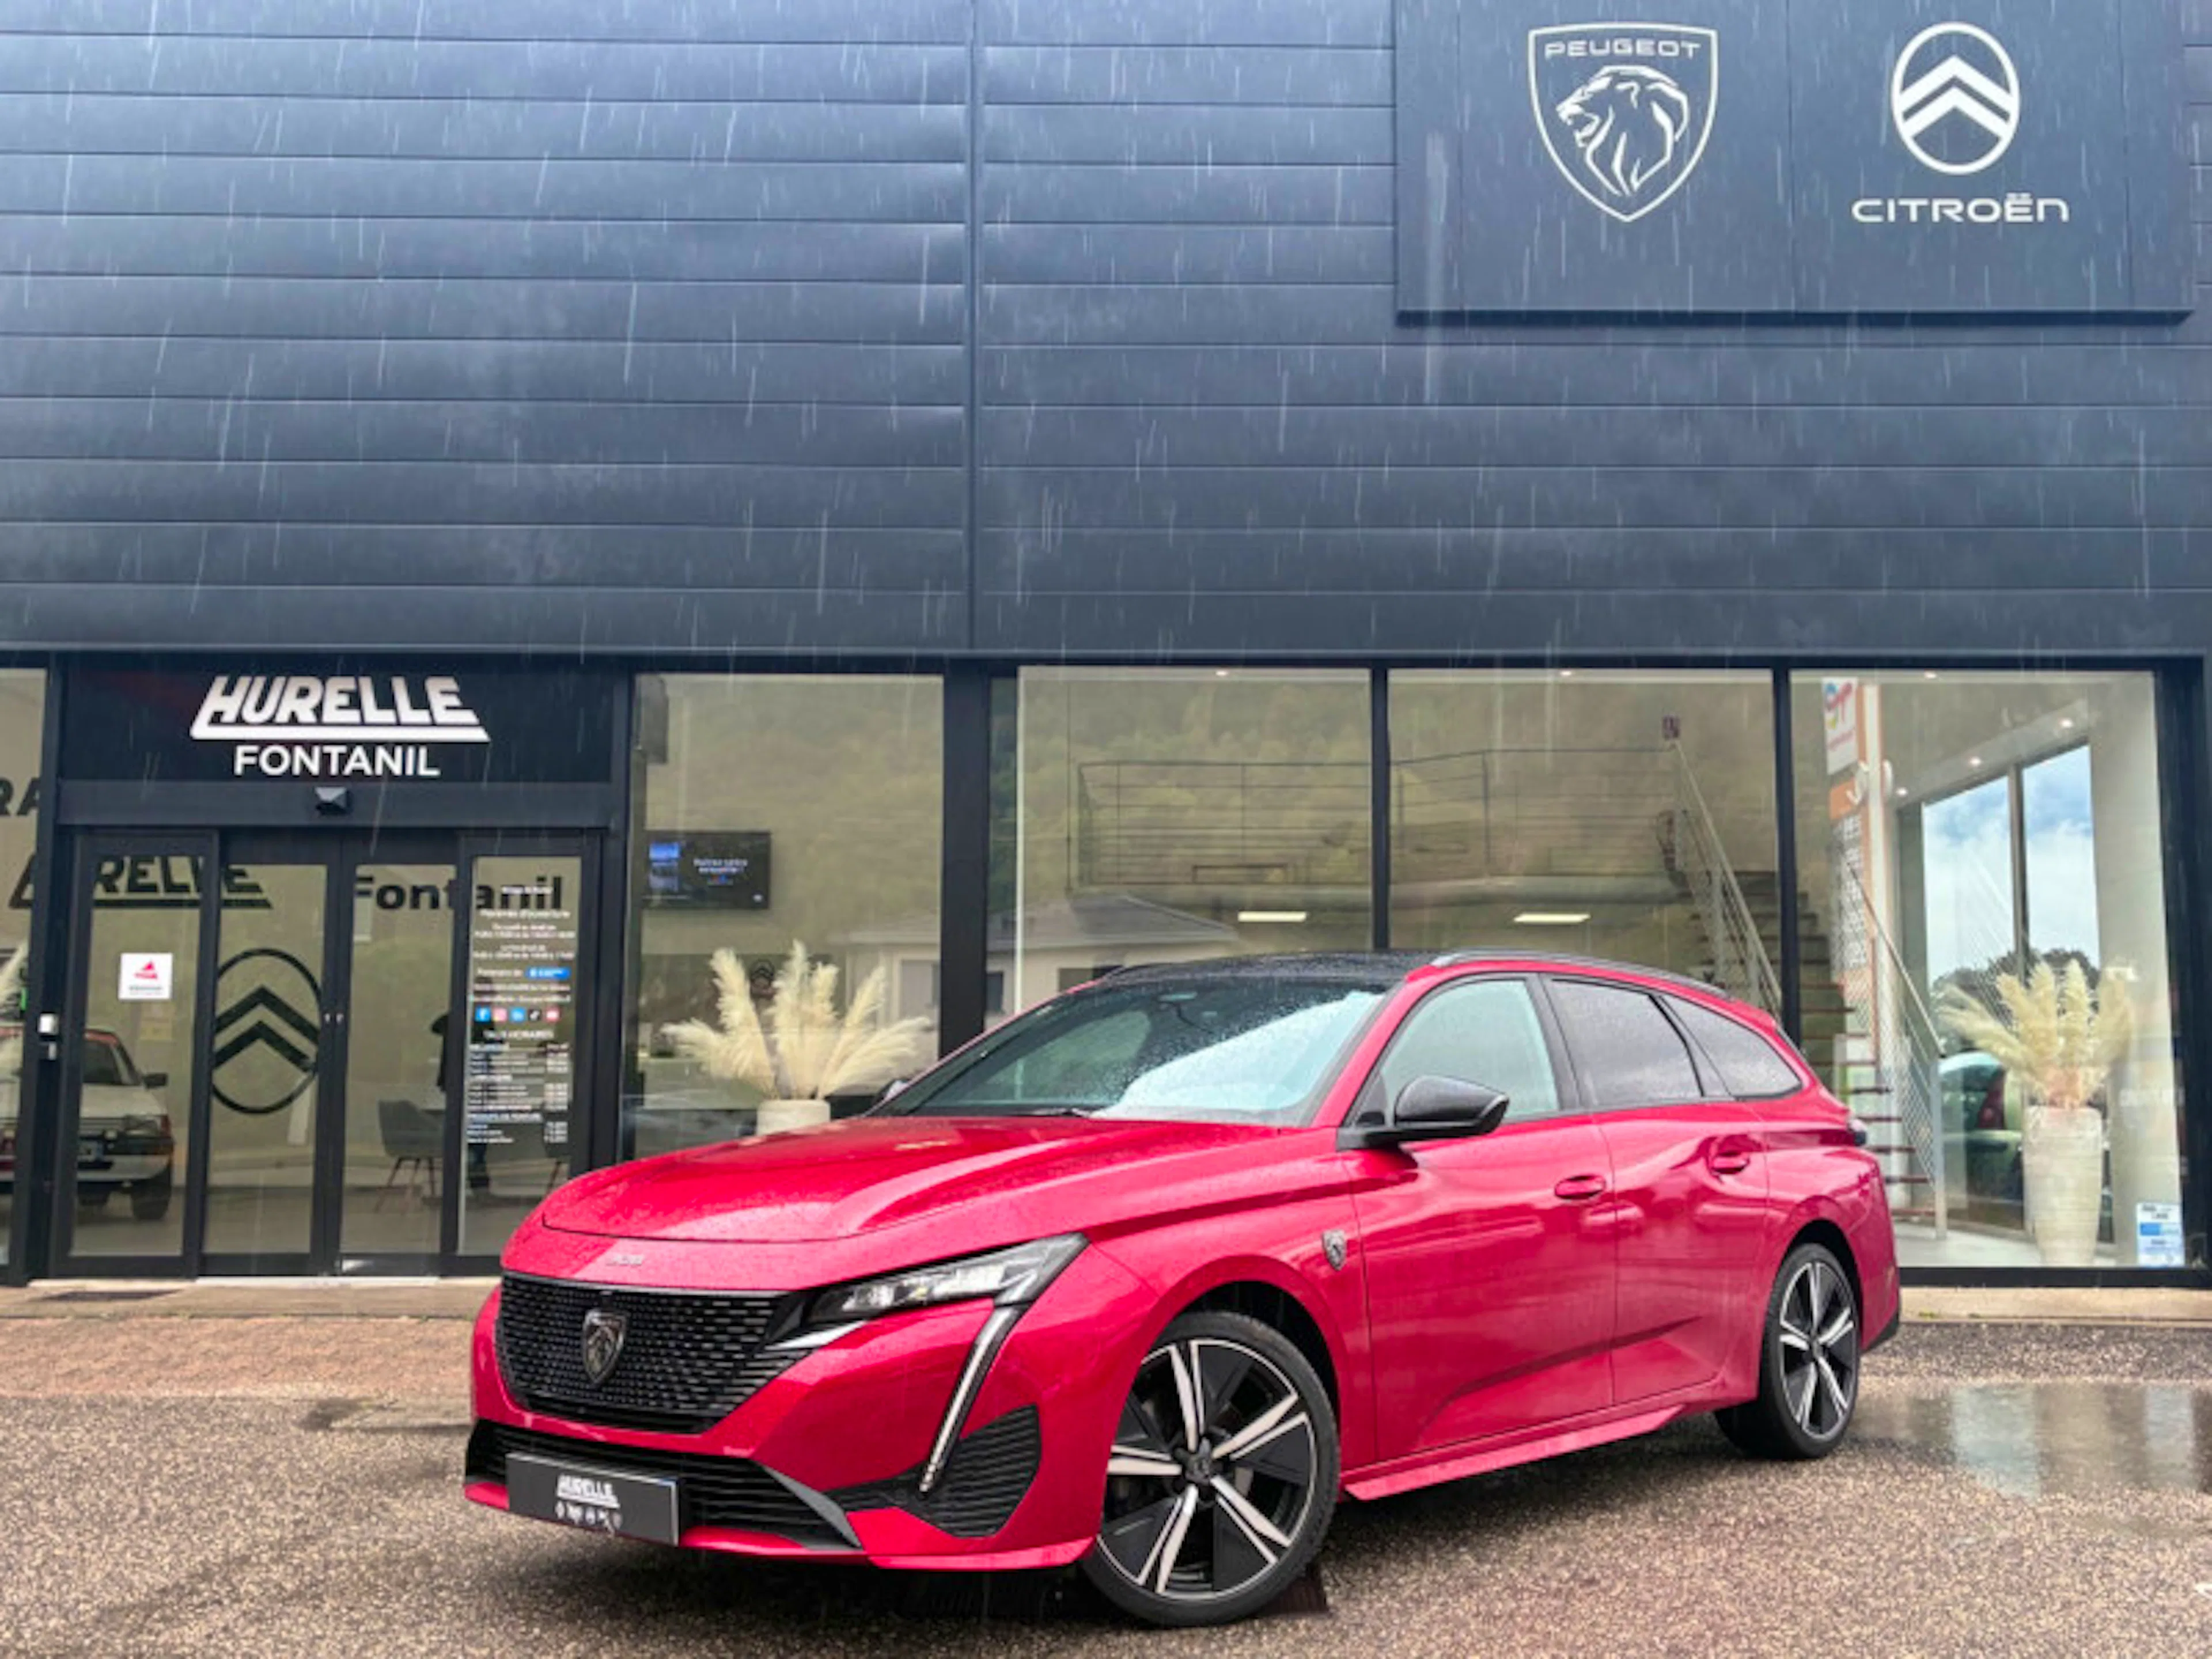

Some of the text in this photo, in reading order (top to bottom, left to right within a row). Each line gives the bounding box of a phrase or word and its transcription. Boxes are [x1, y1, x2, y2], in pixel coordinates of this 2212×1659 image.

[1545, 38, 1701, 60] PEUGEOT
[190, 676, 491, 740] HURELLE
[234, 745, 441, 776] FONTANIL
